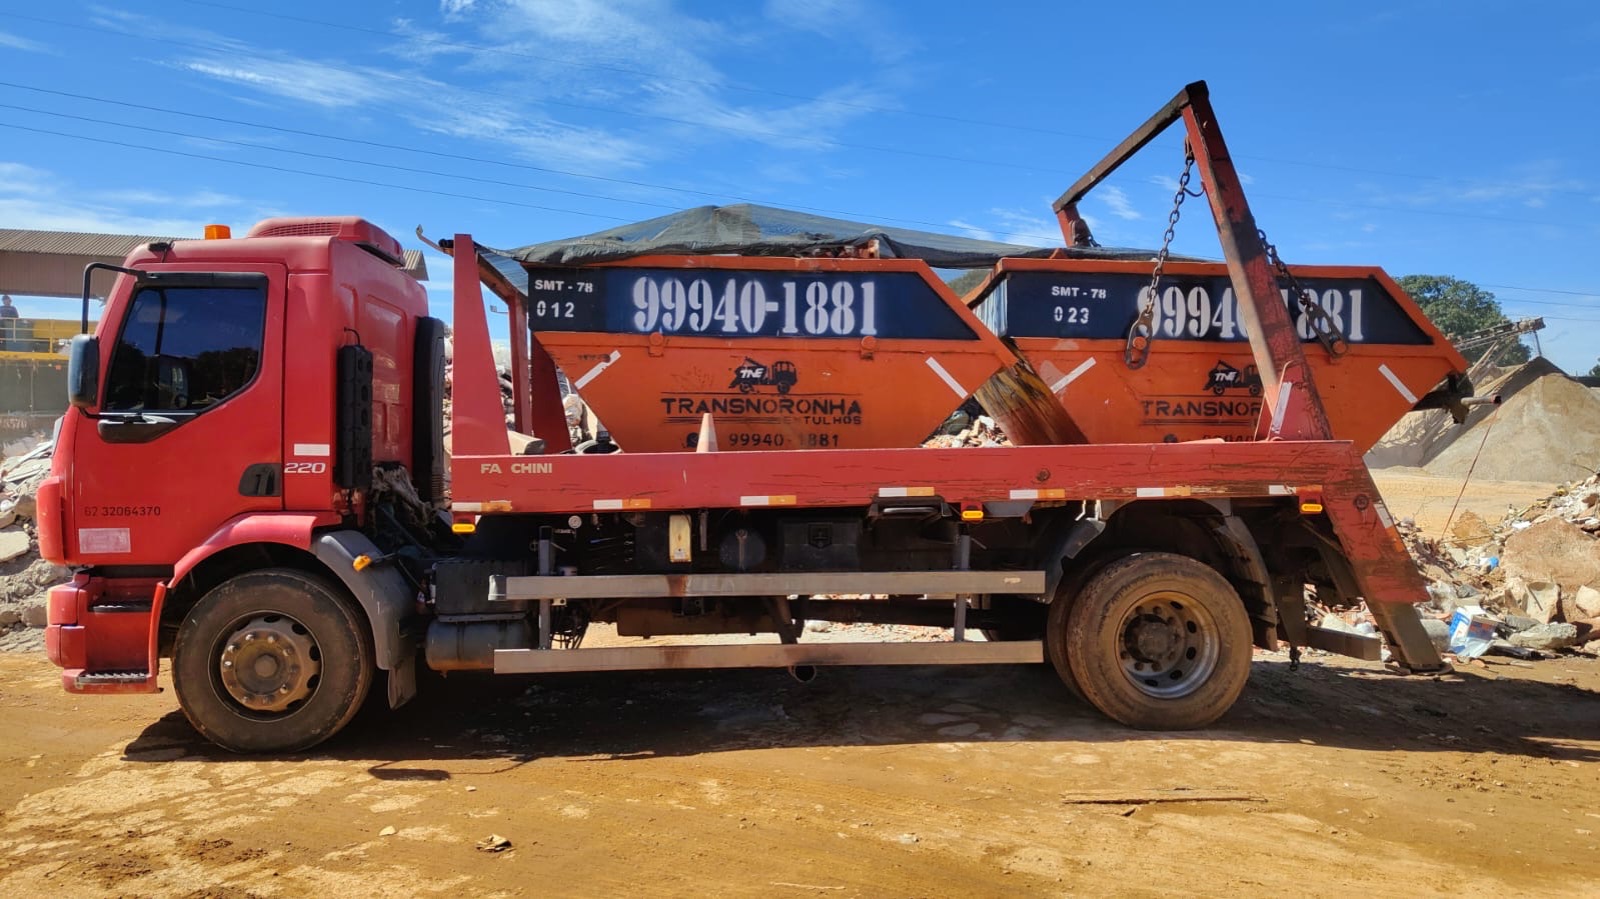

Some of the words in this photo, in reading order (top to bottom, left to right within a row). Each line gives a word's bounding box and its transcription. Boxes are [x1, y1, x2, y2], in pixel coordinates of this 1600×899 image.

[535, 279, 565, 291] SMT
[576, 281, 594, 293] 78
[1051, 286, 1080, 297] SMT
[1090, 288, 1107, 299] 78
[537, 300, 575, 318] 012
[633, 276, 877, 336] 99940-1881
[1054, 306, 1090, 324] 023
[660, 398, 862, 416] TRANSNORONHA
[284, 462, 326, 474] 220
[101, 505, 161, 517] 32064370
